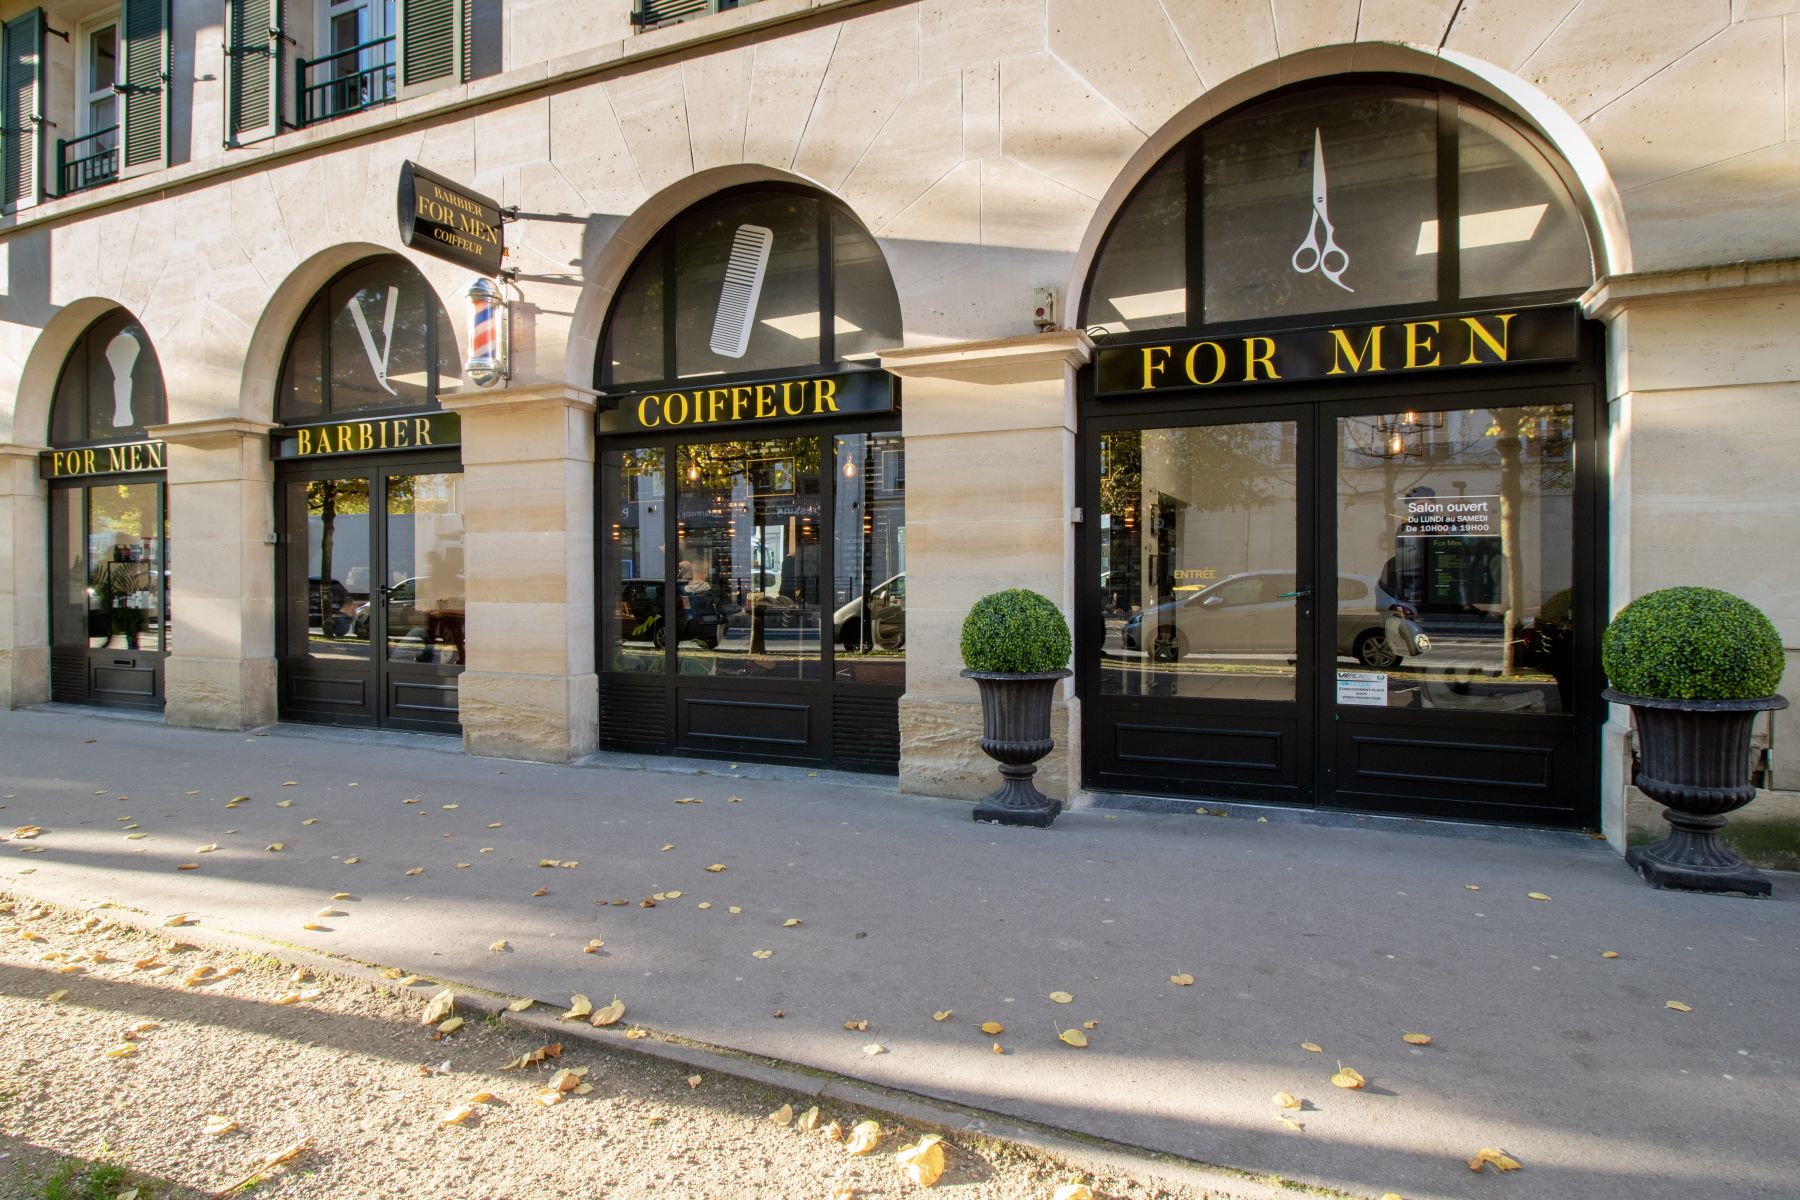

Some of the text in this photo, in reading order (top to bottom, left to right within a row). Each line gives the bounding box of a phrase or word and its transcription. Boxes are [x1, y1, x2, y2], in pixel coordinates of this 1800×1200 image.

[434, 186, 483, 217] BARBIER
[418, 195, 498, 244] FOR MEN
[434, 228, 482, 255] COIFFEUR
[1140, 313, 1518, 390] FOR MEN
[638, 379, 840, 428] COIFFEUR
[298, 418, 433, 456] BARBIER
[53, 443, 163, 476] FOR MEN
[1408, 501, 1488, 513] Salon ouvert
[1174, 567, 1217, 579] ENTRÉE
